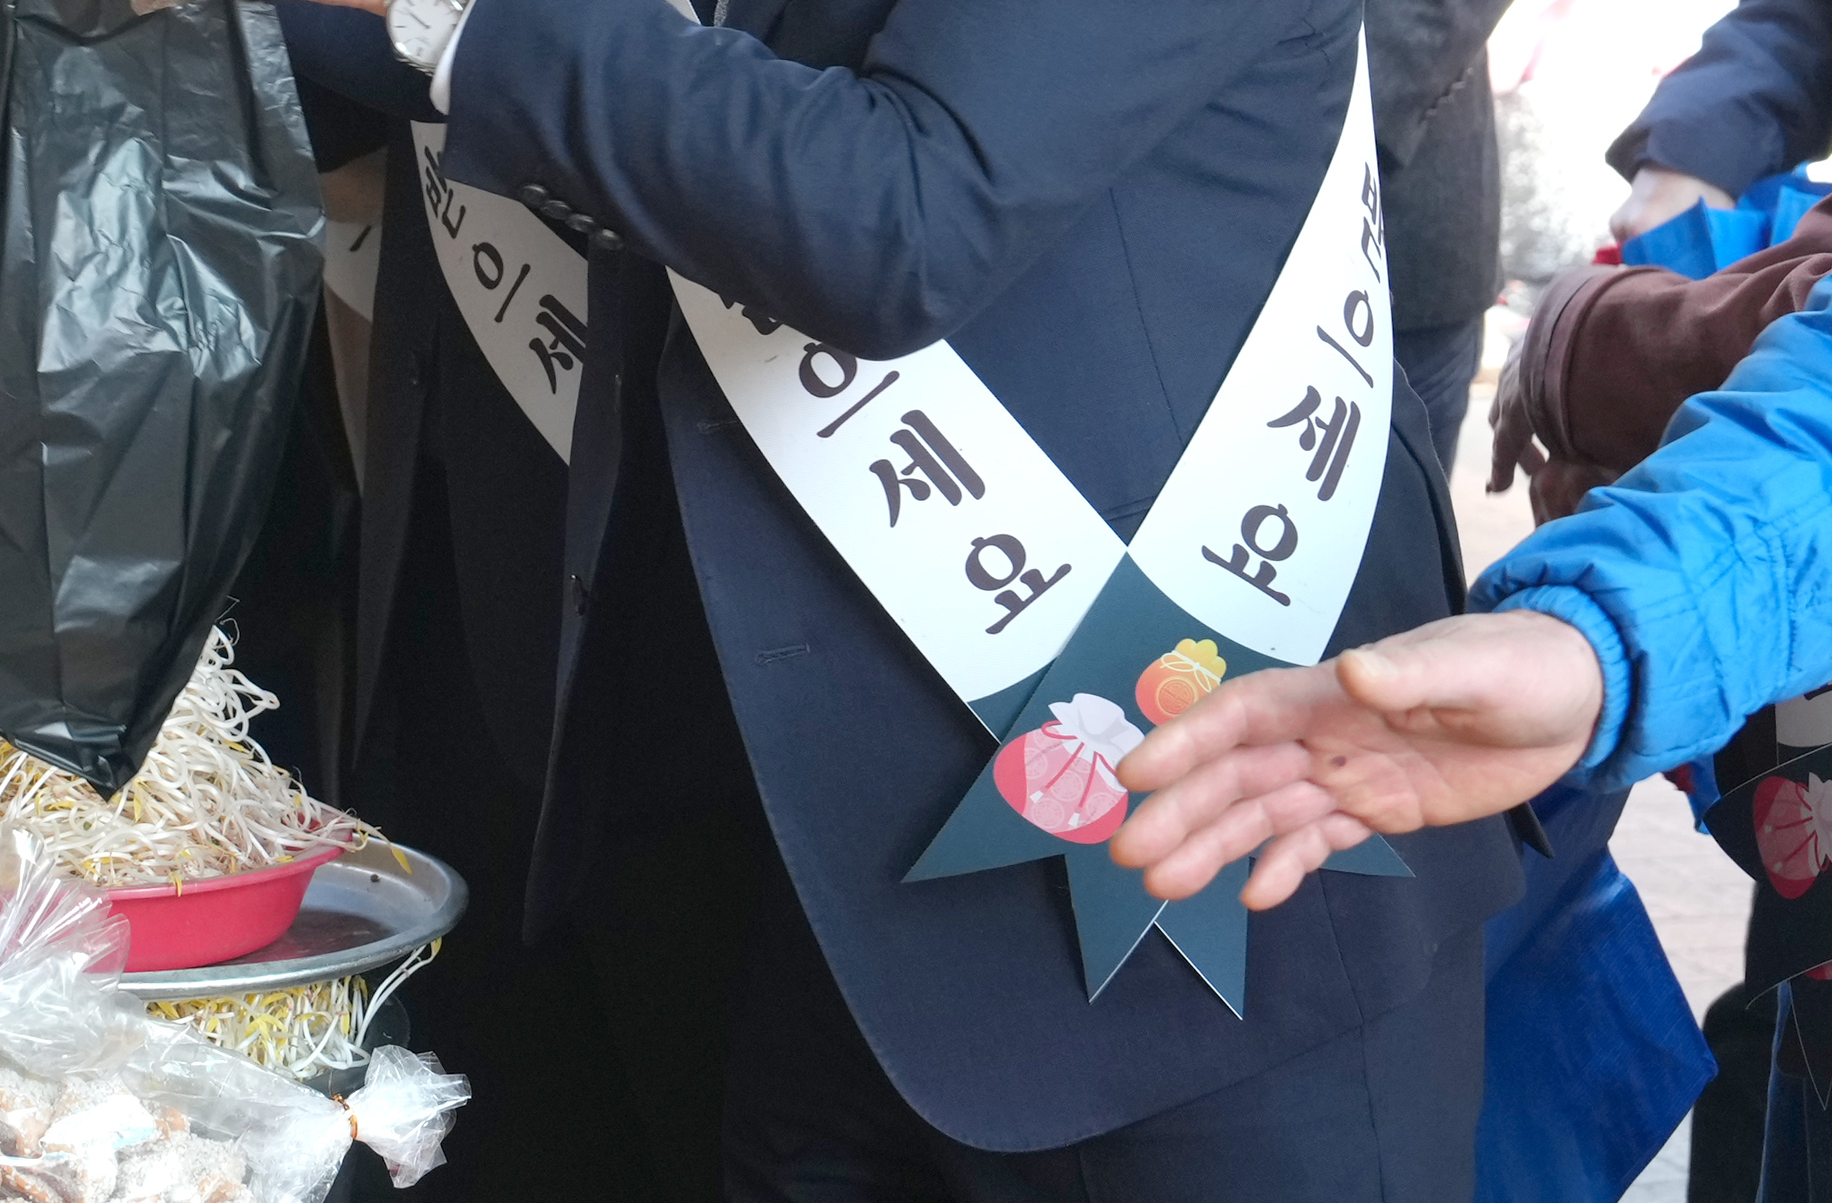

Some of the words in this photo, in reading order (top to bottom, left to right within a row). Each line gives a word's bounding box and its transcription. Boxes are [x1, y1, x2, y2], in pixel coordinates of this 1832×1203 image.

[424, 145, 589, 395] 받으세
[1200, 160, 1386, 607] 받으세요
[720, 298, 1072, 635] 으세요
